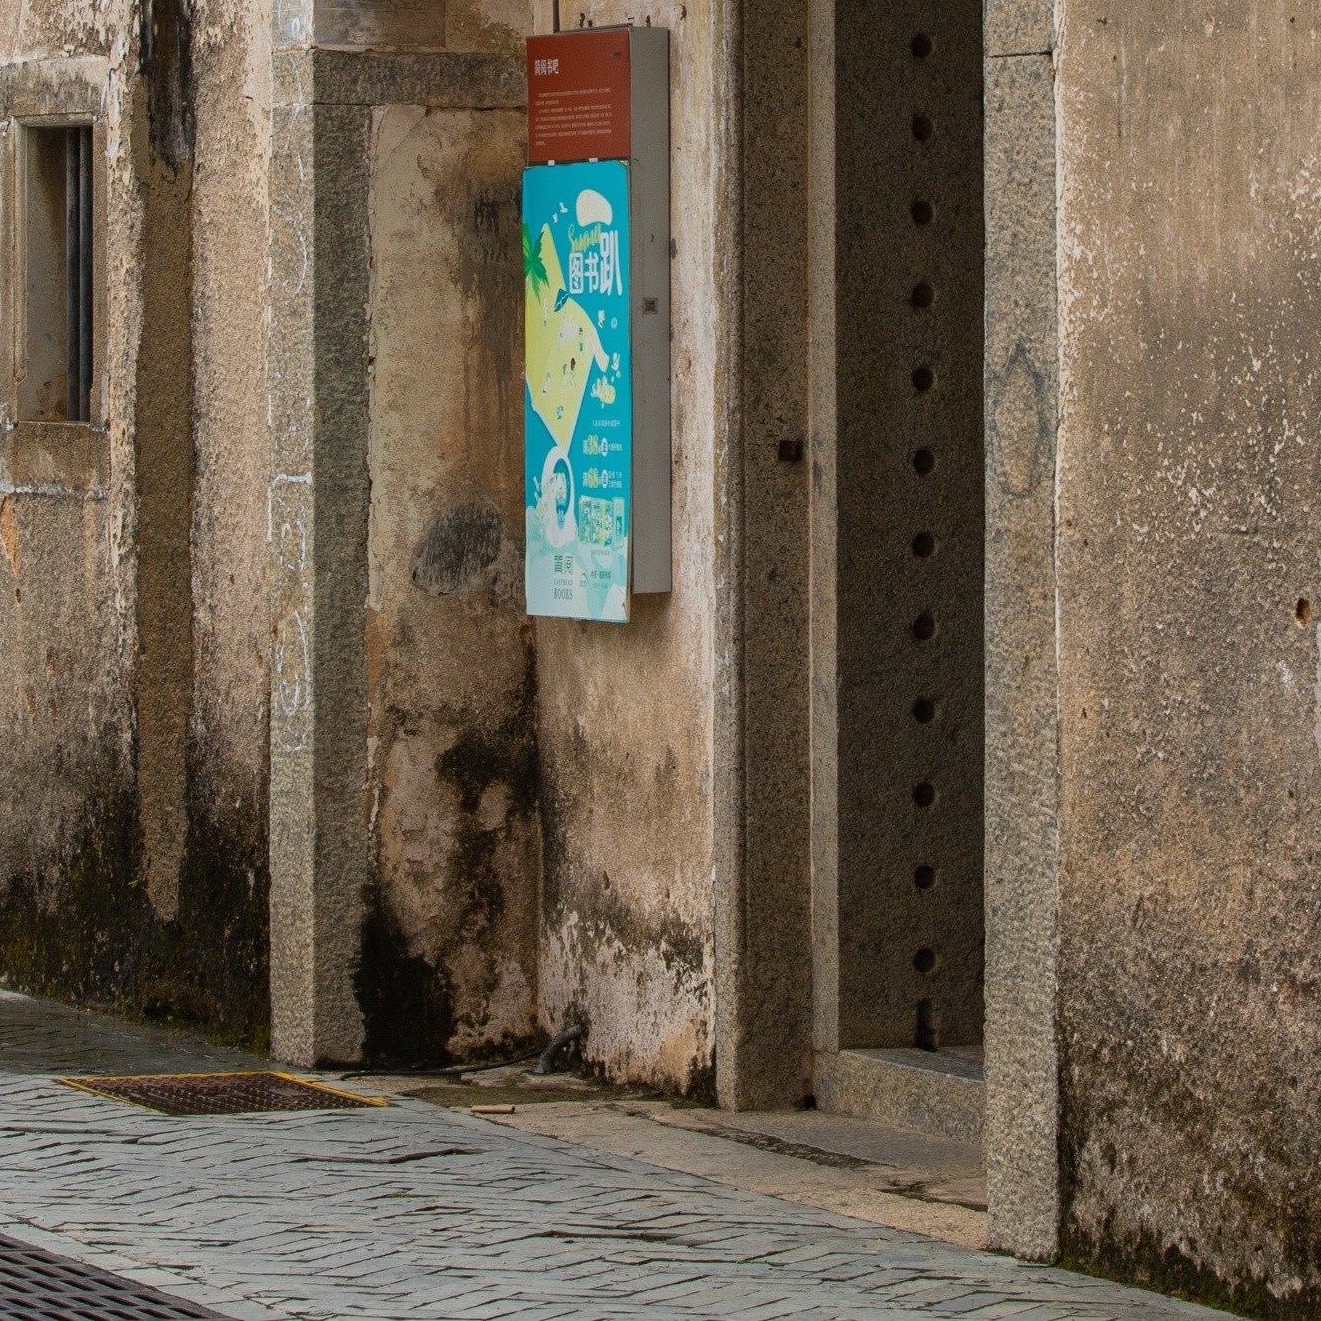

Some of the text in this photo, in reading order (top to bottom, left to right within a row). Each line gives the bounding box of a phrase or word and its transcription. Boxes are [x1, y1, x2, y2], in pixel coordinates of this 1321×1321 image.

[569, 230, 623, 296] 图书趴
[554, 587, 573, 600] BOOKS
